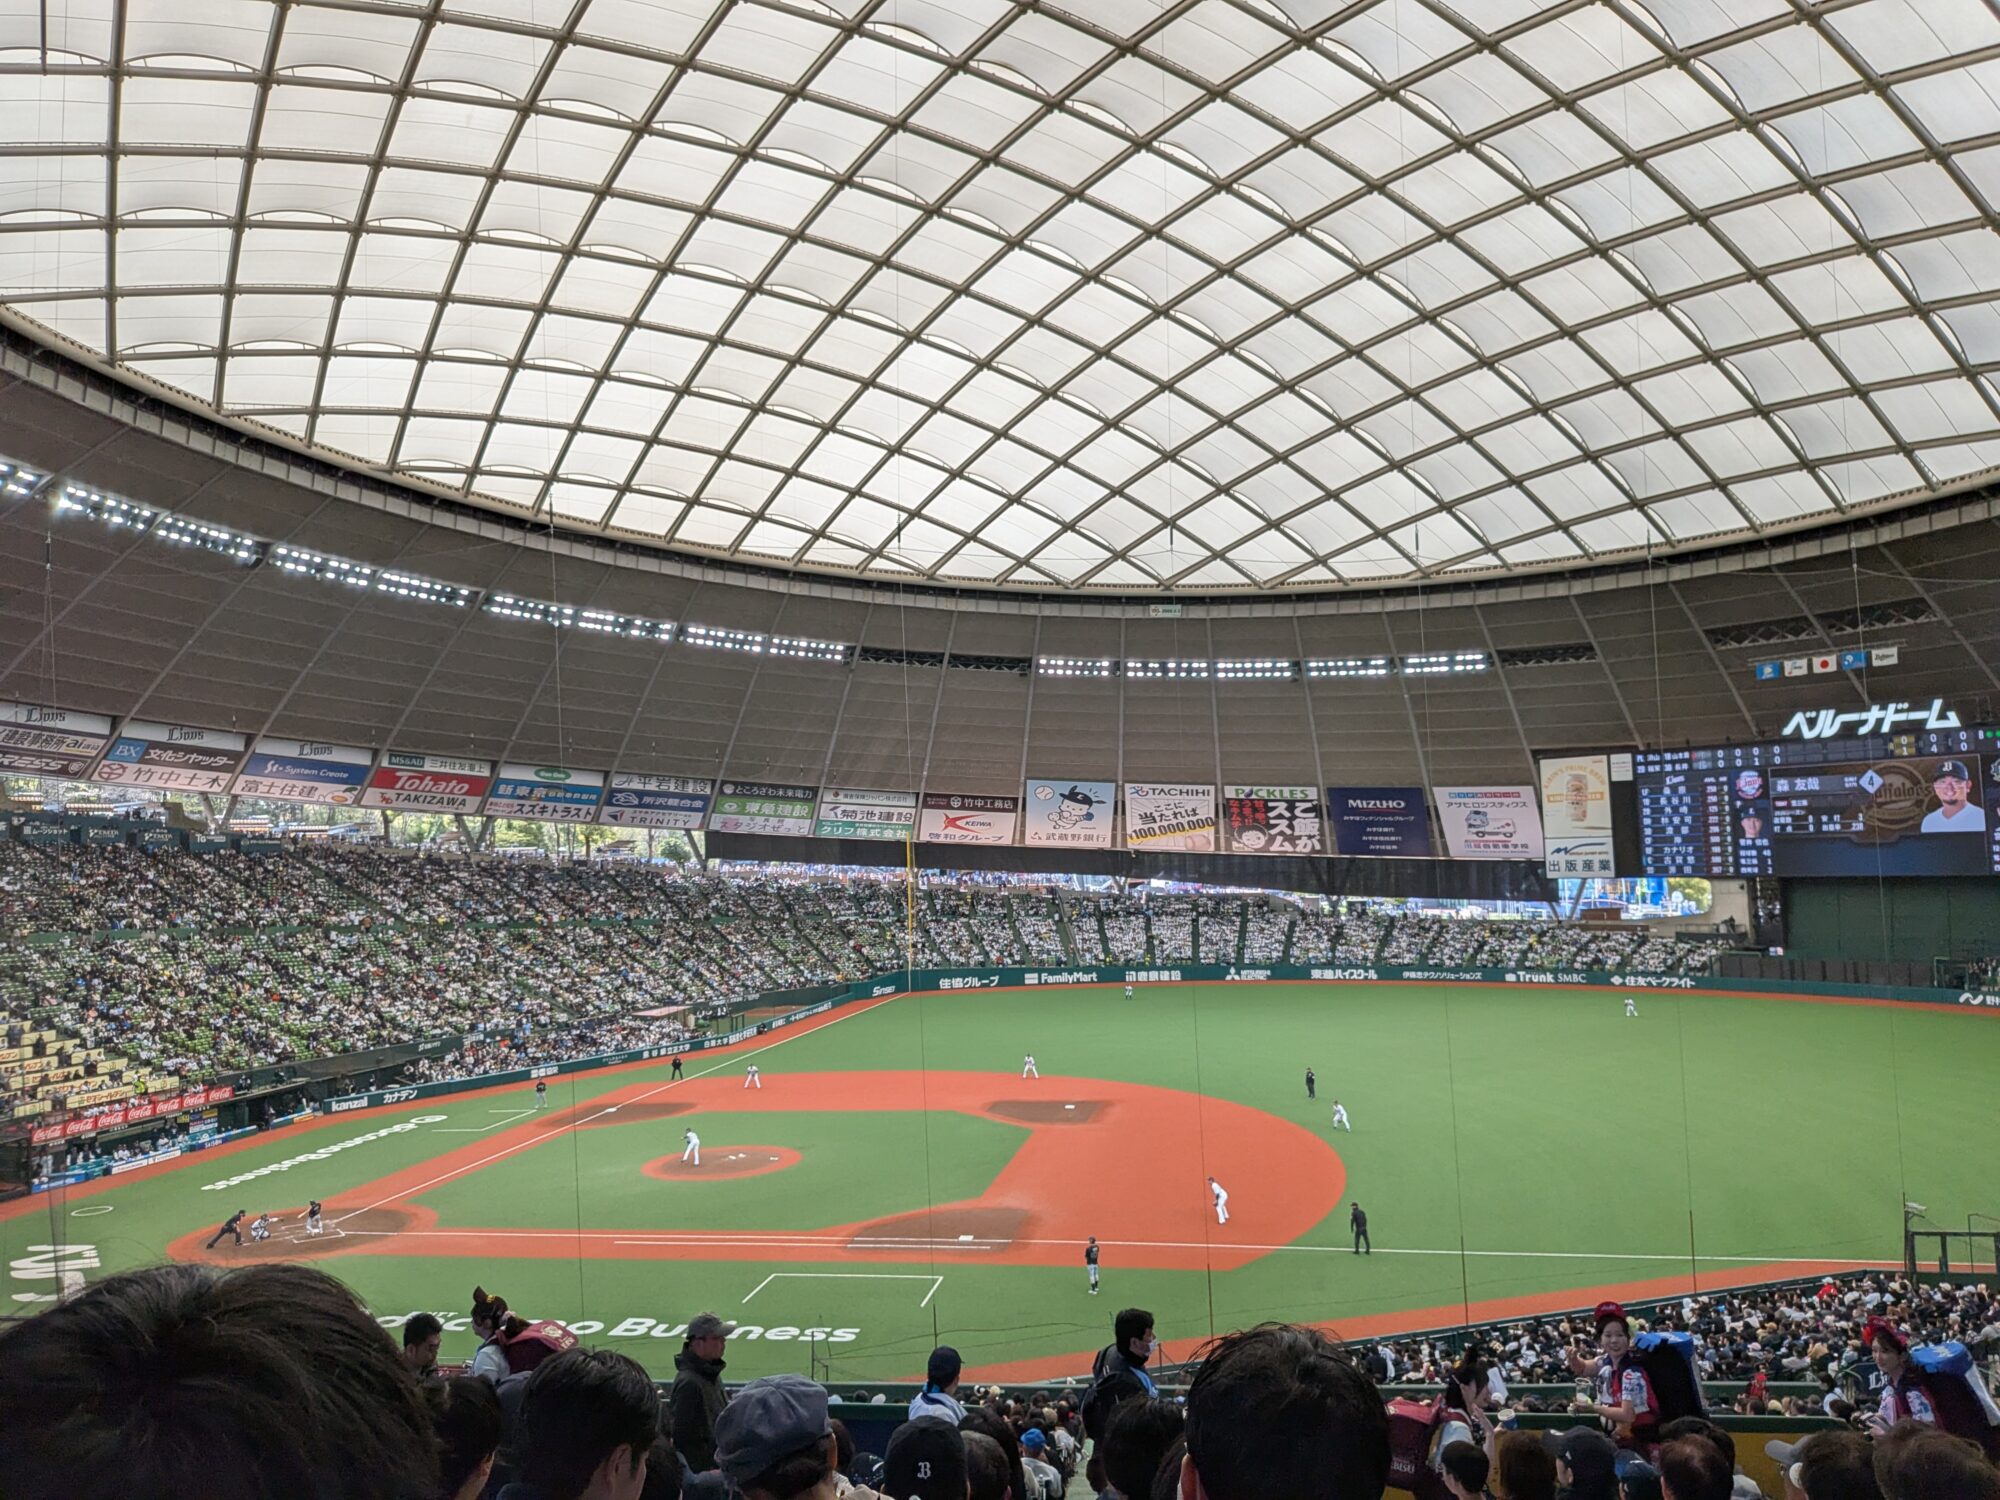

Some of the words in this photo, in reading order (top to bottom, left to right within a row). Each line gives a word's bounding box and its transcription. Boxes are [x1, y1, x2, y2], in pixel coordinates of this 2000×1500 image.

[1782, 698, 1961, 739] ベルーナドーム
[166, 727, 205, 741] Lions
[1901, 736, 1907, 745] 0
[1930, 734, 1936, 742] 0
[1960, 731, 1966, 740] 0
[115, 744, 140, 757] BX
[298, 742, 333, 756] Lions
[1717, 750, 1723, 758] 0
[1735, 748, 1741, 757] 0
[1753, 747, 1759, 755] 0
[1773, 745, 1779, 754] 0
[1961, 742, 1967, 751] 0
[145, 748, 235, 767] 文化シャッター
[391, 756, 423, 767] MS&AD
[1718, 759, 1724, 768] 0
[1735, 758, 1742, 767] 0
[1754, 757, 1759, 766] 1
[1774, 756, 1780, 764] 0
[285, 765, 318, 776] System
[319, 769, 349, 779] Create
[429, 759, 485, 773] 三井住友海上
[133, 767, 226, 788] 竹中土木
[395, 771, 469, 794] Tohato
[637, 775, 708, 793] 平岩建設
[240, 780, 319, 798] 富士住建
[736, 785, 813, 799] ところざわ未来電力
[1148, 787, 1210, 796] TACHIHI
[394, 792, 467, 808] TAKIZAWA
[964, 798, 1013, 809] 竹中工務店
[1154, 802, 1185, 812] ここに
[1348, 799, 1406, 809] MIZUHO
[513, 803, 593, 820] スズキトラスト
[745, 802, 809, 817] 東急建設
[840, 809, 913, 822] 菊池建設
[1138, 807, 1199, 825] 当たれば
[630, 816, 690, 826] TRINITY
[1267, 801, 1294, 852] ススム
[1293, 800, 1321, 853] ご飯が
[928, 833, 1005, 842] 啓和グループ
[1045, 833, 1108, 842] 武蔵野銀行
[1548, 859, 1611, 872] 出版産業
[1041, 972, 1097, 984] FamilyMart
[1311, 969, 1378, 980] 東進ハイスクール
[1517, 971, 1556, 983] Trunk
[1557, 973, 1587, 983] SMBC
[939, 976, 999, 989] 住協グループ
[1625, 976, 1696, 988] 住友ベークライト
[384, 1088, 418, 1103] カナデン
[607, 1317, 861, 1342] Buness
[917, 1462, 931, 1480] B
